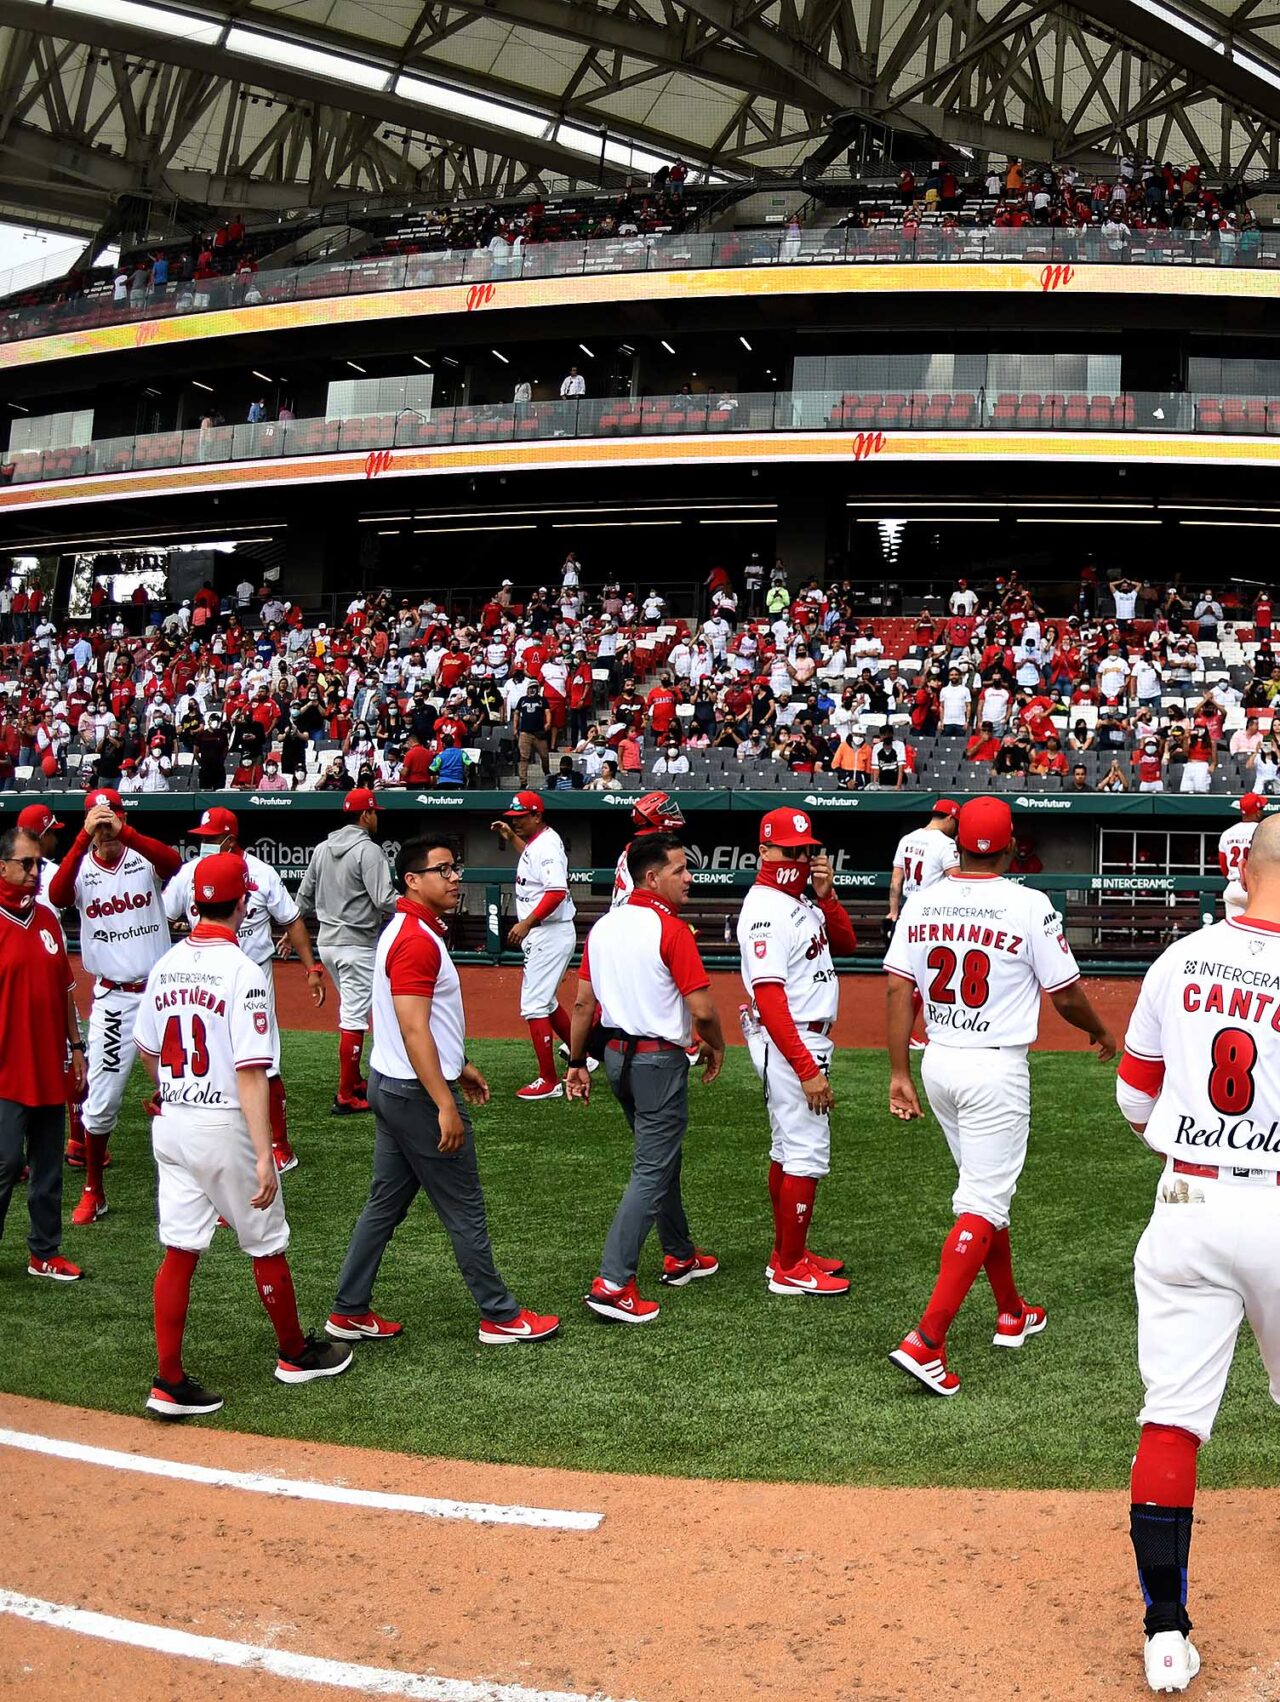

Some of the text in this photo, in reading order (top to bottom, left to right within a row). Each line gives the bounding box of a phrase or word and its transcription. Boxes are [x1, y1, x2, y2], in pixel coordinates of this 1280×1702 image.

[259, 797, 291, 805] Profuturo
[428, 796, 463, 805] Profuturo
[615, 796, 640, 805] Profut
[817, 798, 858, 806] Profuturo
[1029, 799, 1071, 808] Profuturo
[1103, 878, 1173, 888] INTERCERAMIC
[932, 907, 1004, 920] INTERCERAMIC
[109, 925, 159, 943] Profuturo
[908, 923, 1024, 954] HERNANDEZ
[927, 945, 990, 1009] 28
[102, 1009, 122, 1073] KAVAK
[160, 1014, 210, 1079] 43
[1208, 1027, 1258, 1116] 8
[1164, 1656, 1172, 1667] 8
